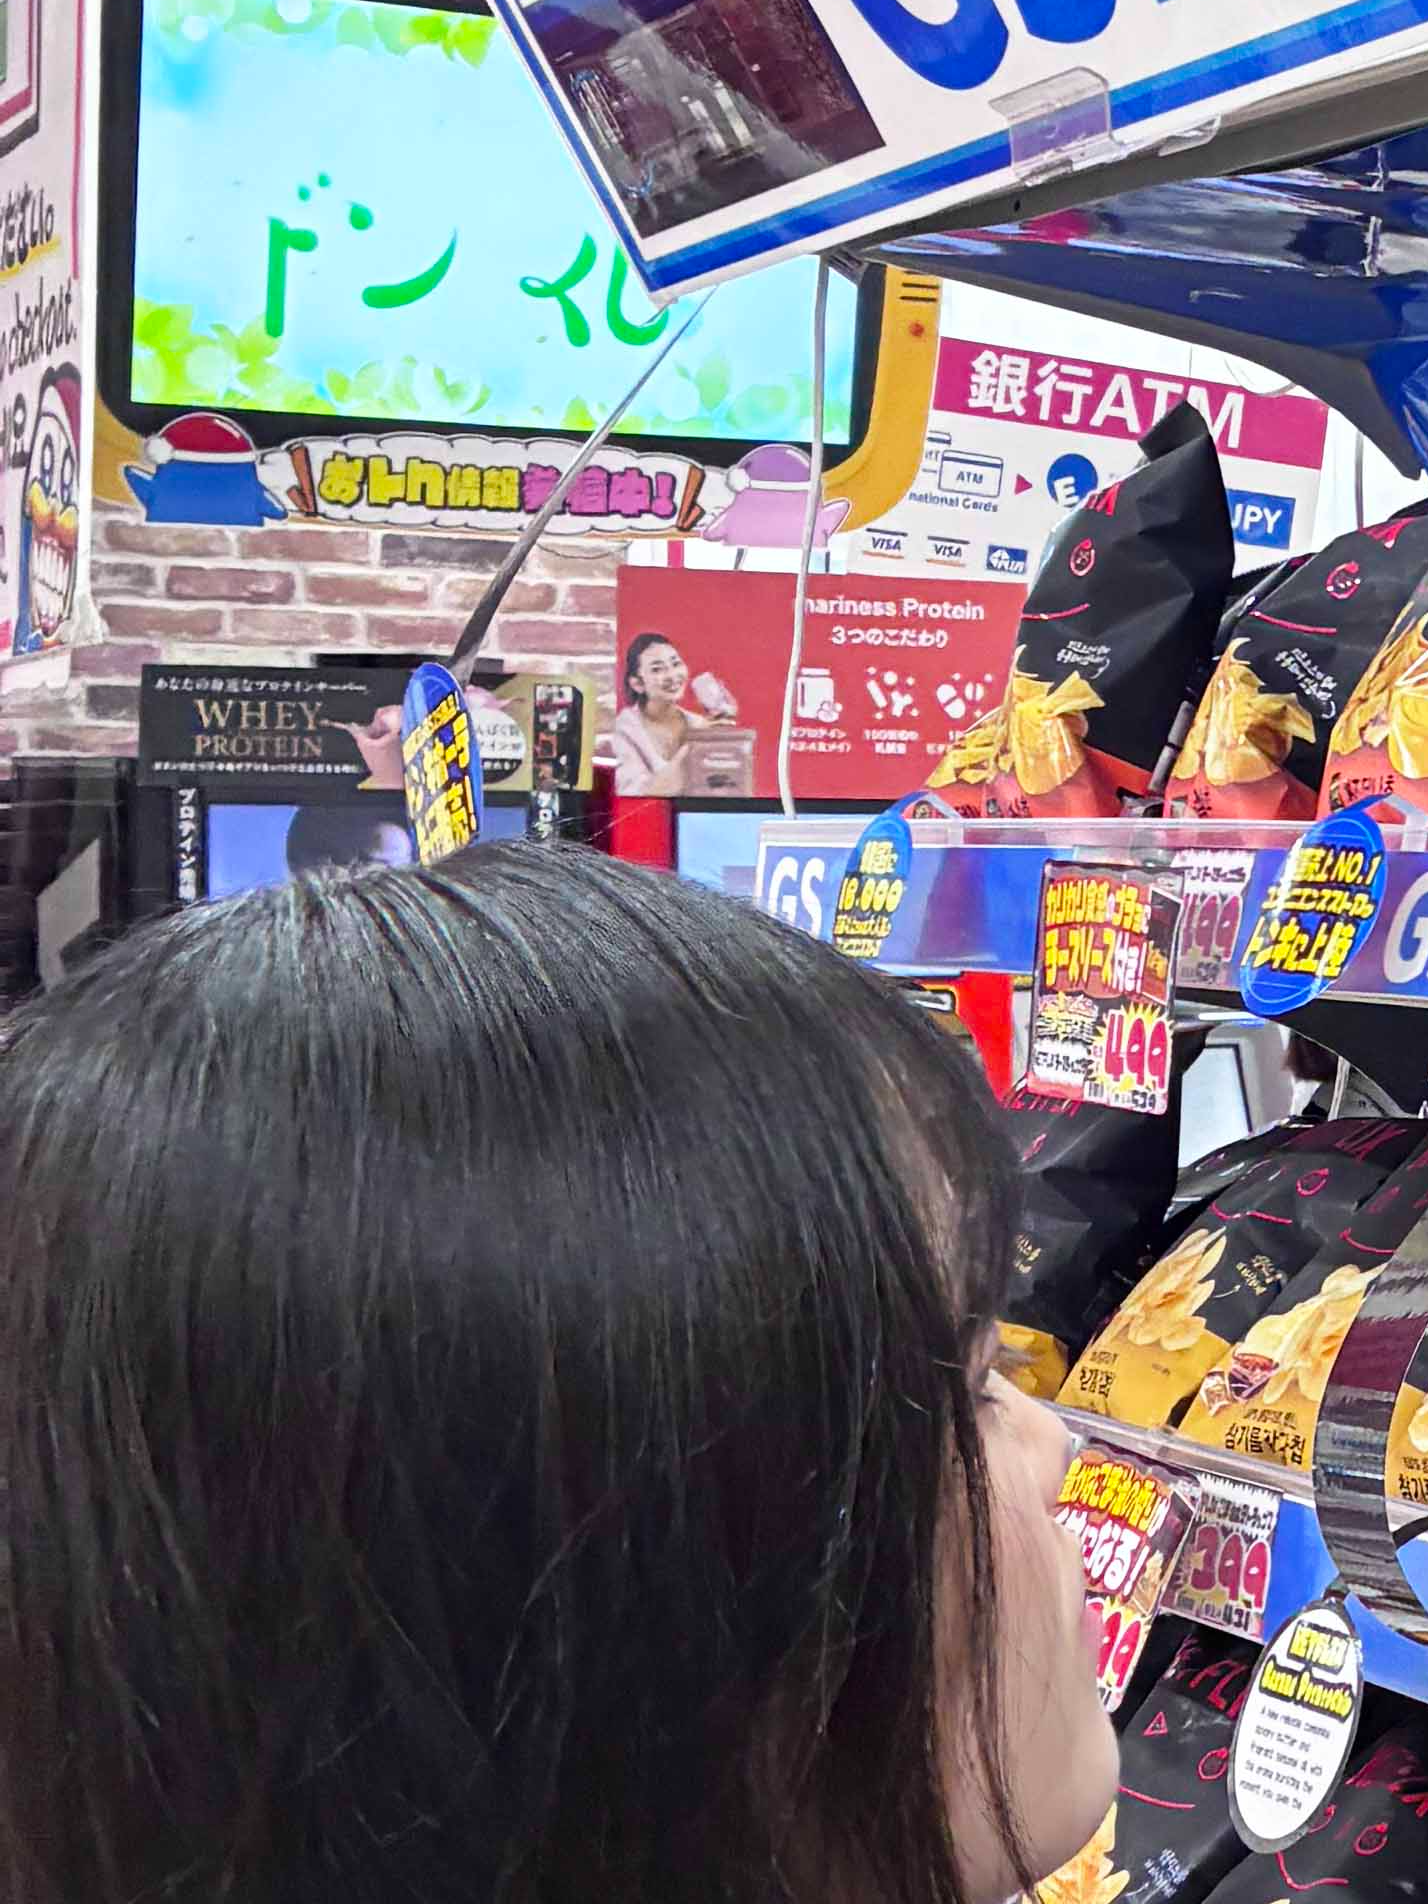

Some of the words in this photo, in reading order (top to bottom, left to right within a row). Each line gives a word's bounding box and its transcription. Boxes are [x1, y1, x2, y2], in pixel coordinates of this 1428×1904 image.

[967, 349, 1245, 449] 銀行ATM
[909, 491, 959, 509] national
[962, 497, 998, 513] Cards
[1231, 502, 1284, 535] JPY
[871, 537, 902, 552] VISA
[934, 544, 963, 558] VISA
[903, 598, 985, 621] Protein
[193, 698, 324, 731] WHEY
[193, 733, 323, 758] PROTEIN
[1334, 852, 1381, 885] NO.1
[769, 849, 824, 939] GS
[1105, 1009, 1171, 1092] 499
[1187, 1523, 1272, 1610] 399
